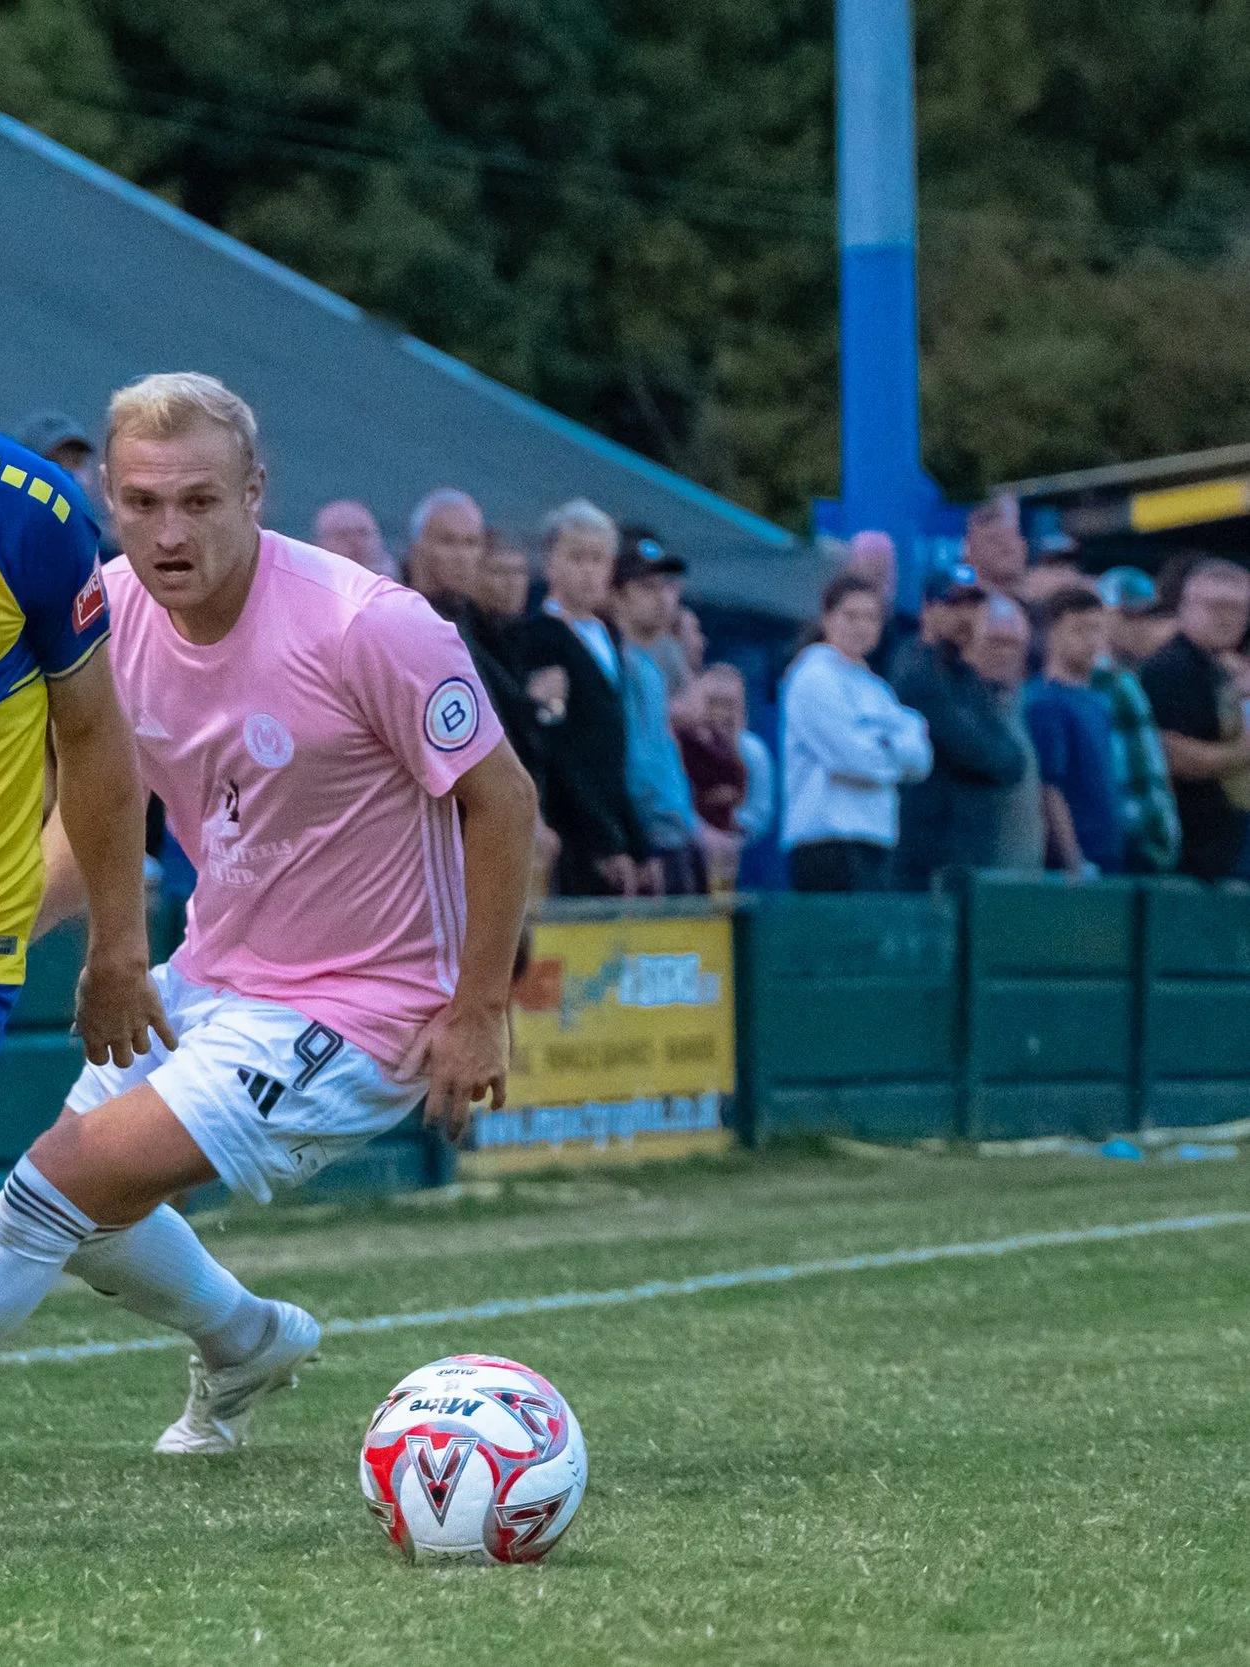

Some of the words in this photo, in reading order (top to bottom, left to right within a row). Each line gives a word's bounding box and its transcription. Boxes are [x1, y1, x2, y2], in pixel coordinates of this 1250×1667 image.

[440, 700, 466, 733] B
[293, 1020, 344, 1091] 9
[410, 1397, 484, 1417] Mitre
